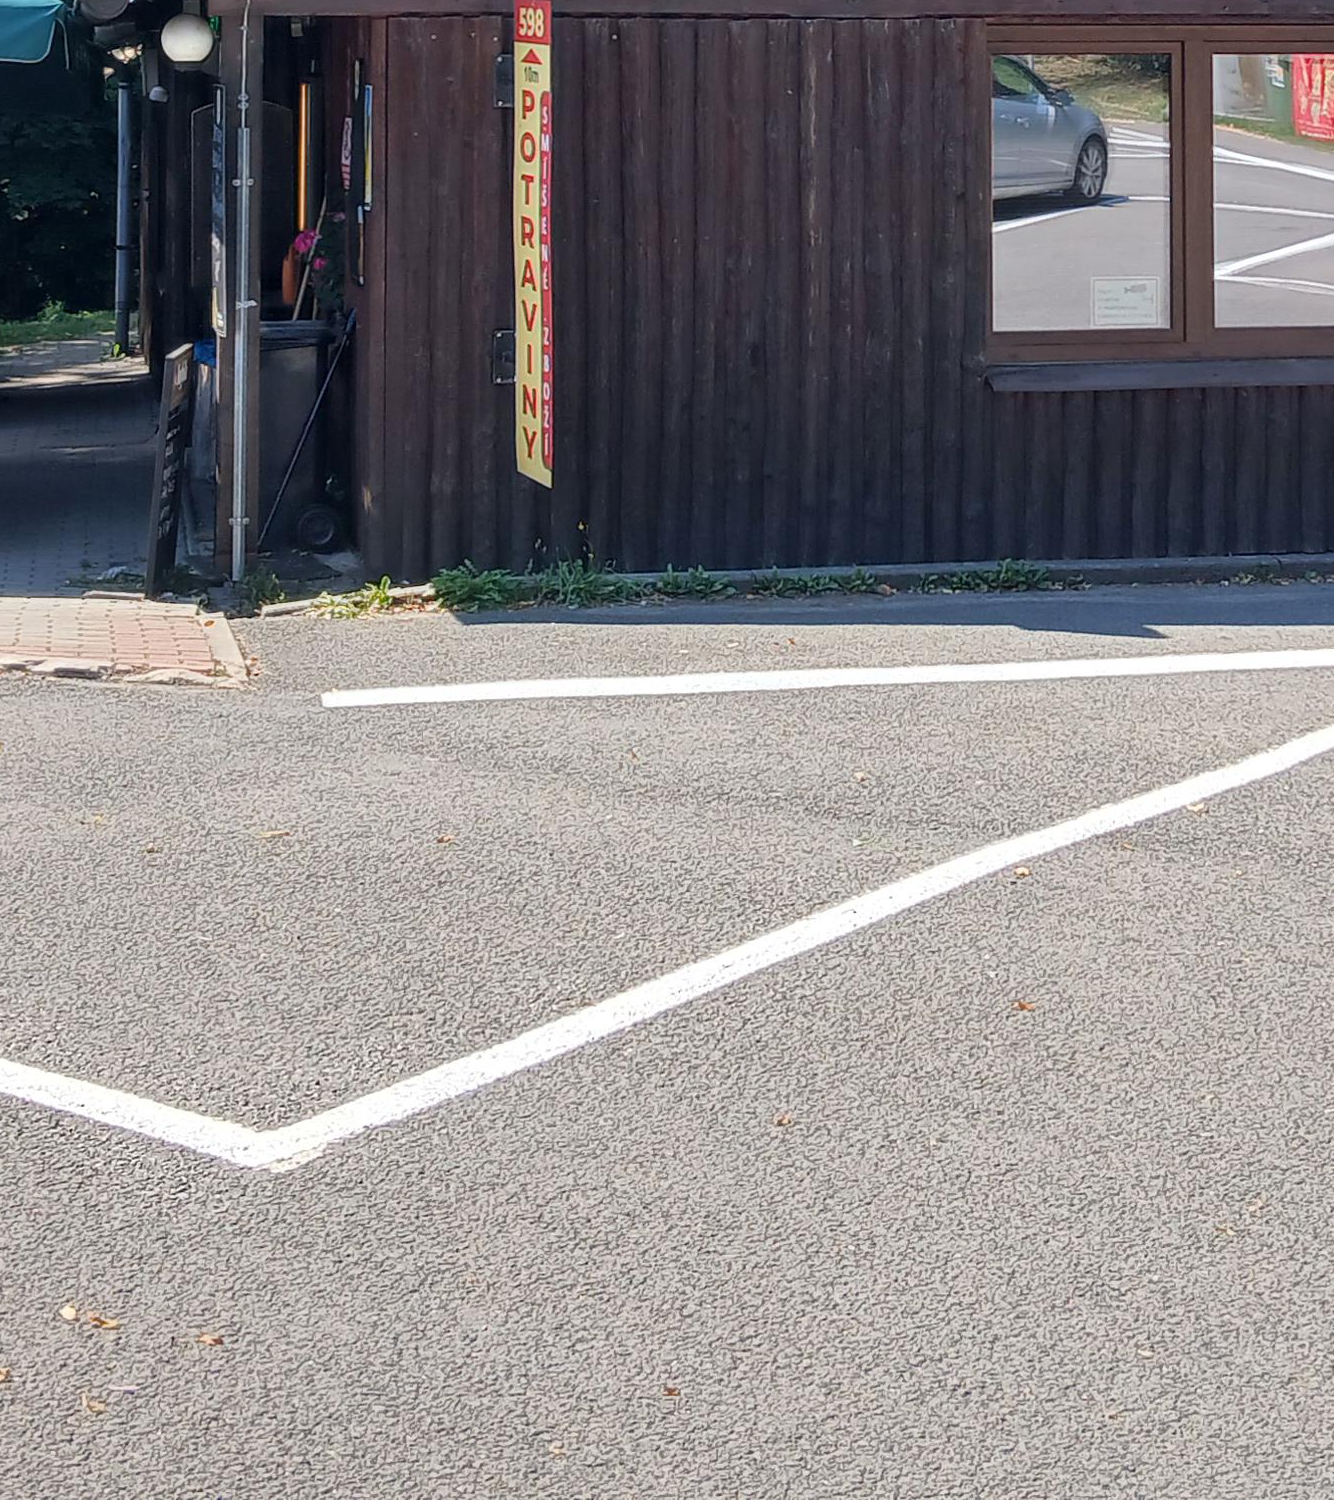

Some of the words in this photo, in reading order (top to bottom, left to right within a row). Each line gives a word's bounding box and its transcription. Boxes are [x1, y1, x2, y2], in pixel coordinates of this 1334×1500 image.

[518, 6, 545, 38] 598
[520, 90, 538, 460] POTRAVINY
[542, 327, 551, 456] ZBOŽÍ
